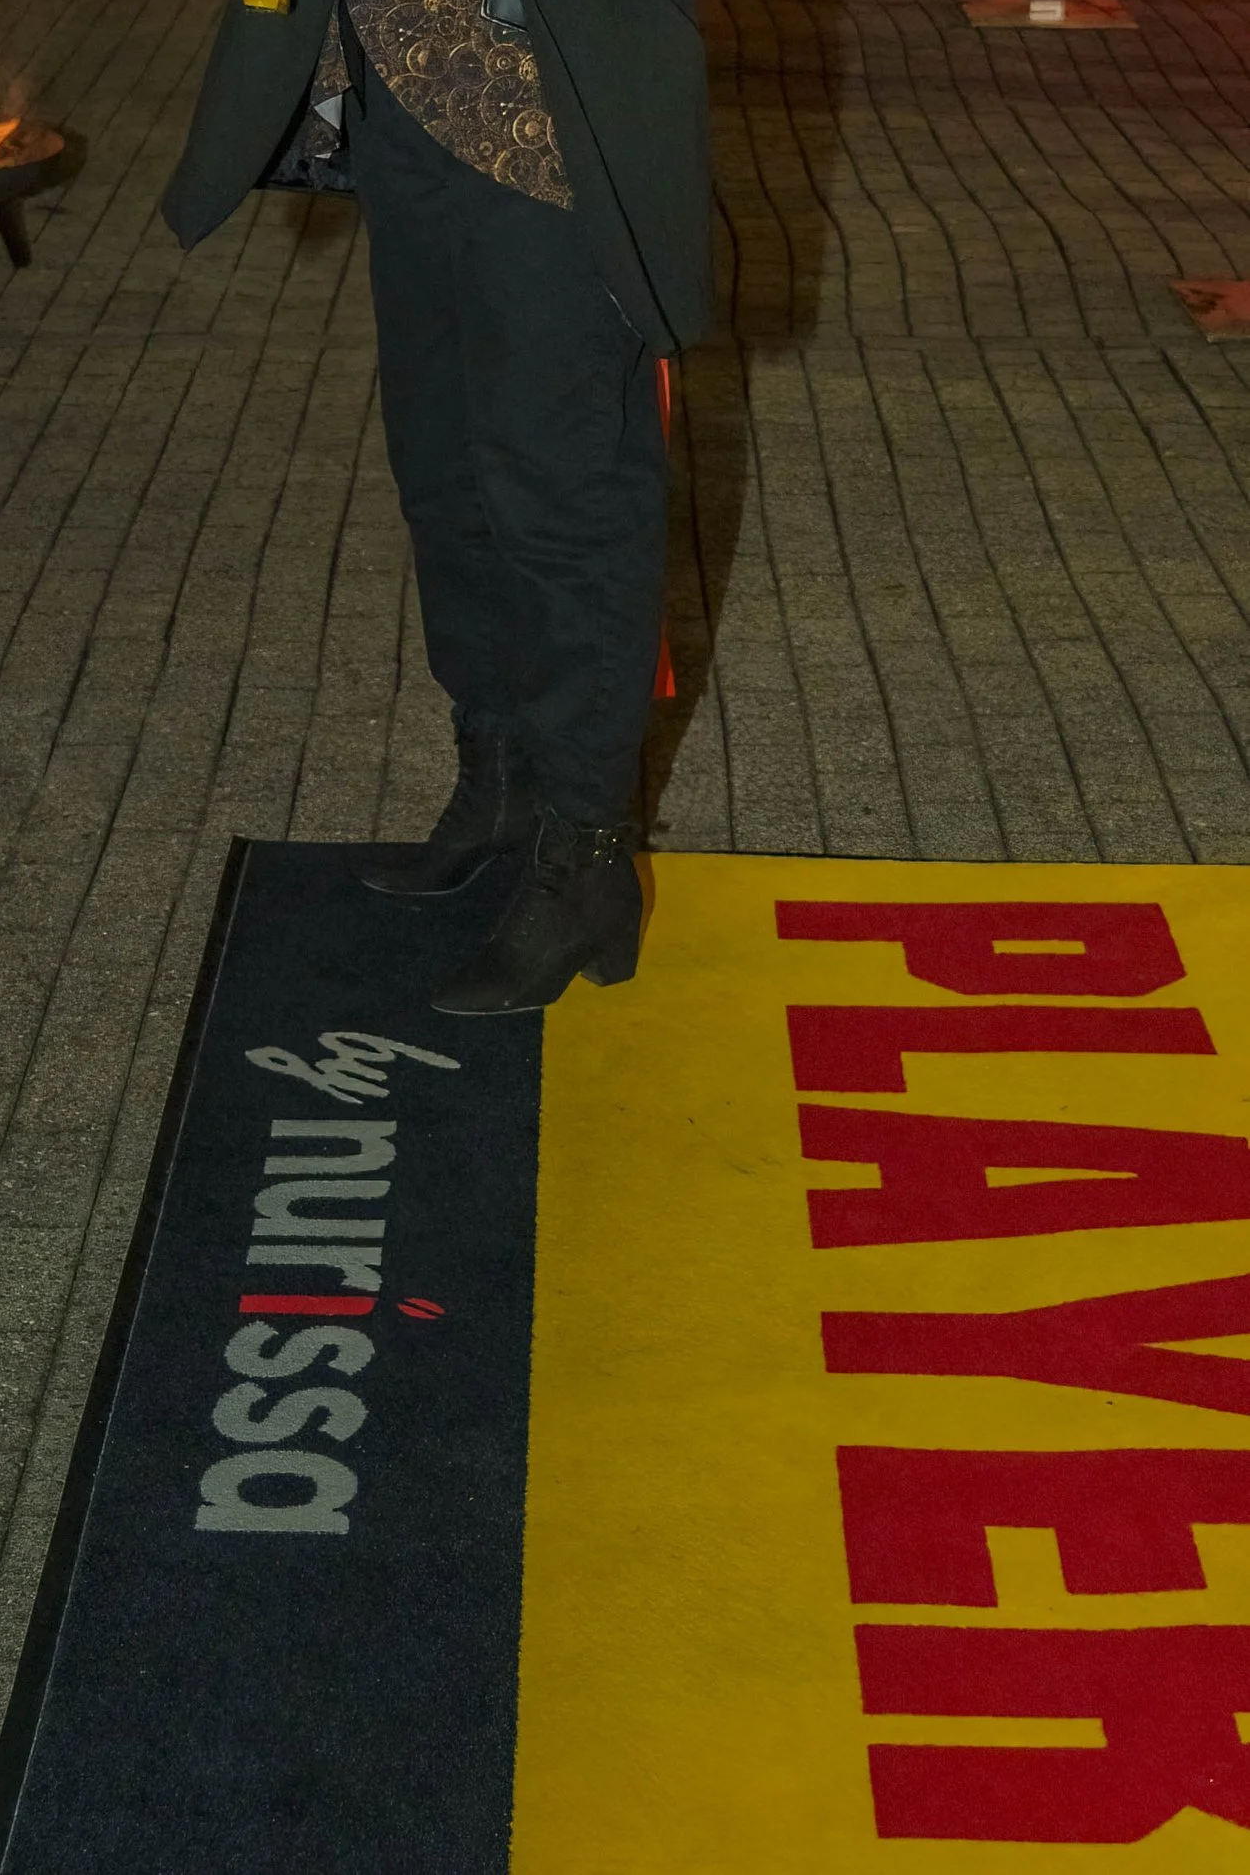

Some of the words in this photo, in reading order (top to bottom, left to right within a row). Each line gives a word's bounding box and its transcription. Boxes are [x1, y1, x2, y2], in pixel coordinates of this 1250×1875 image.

[245, 1030, 461, 1105] by
[195, 1119, 446, 1535] nurissa
[775, 900, 1250, 1844] PLAYER
